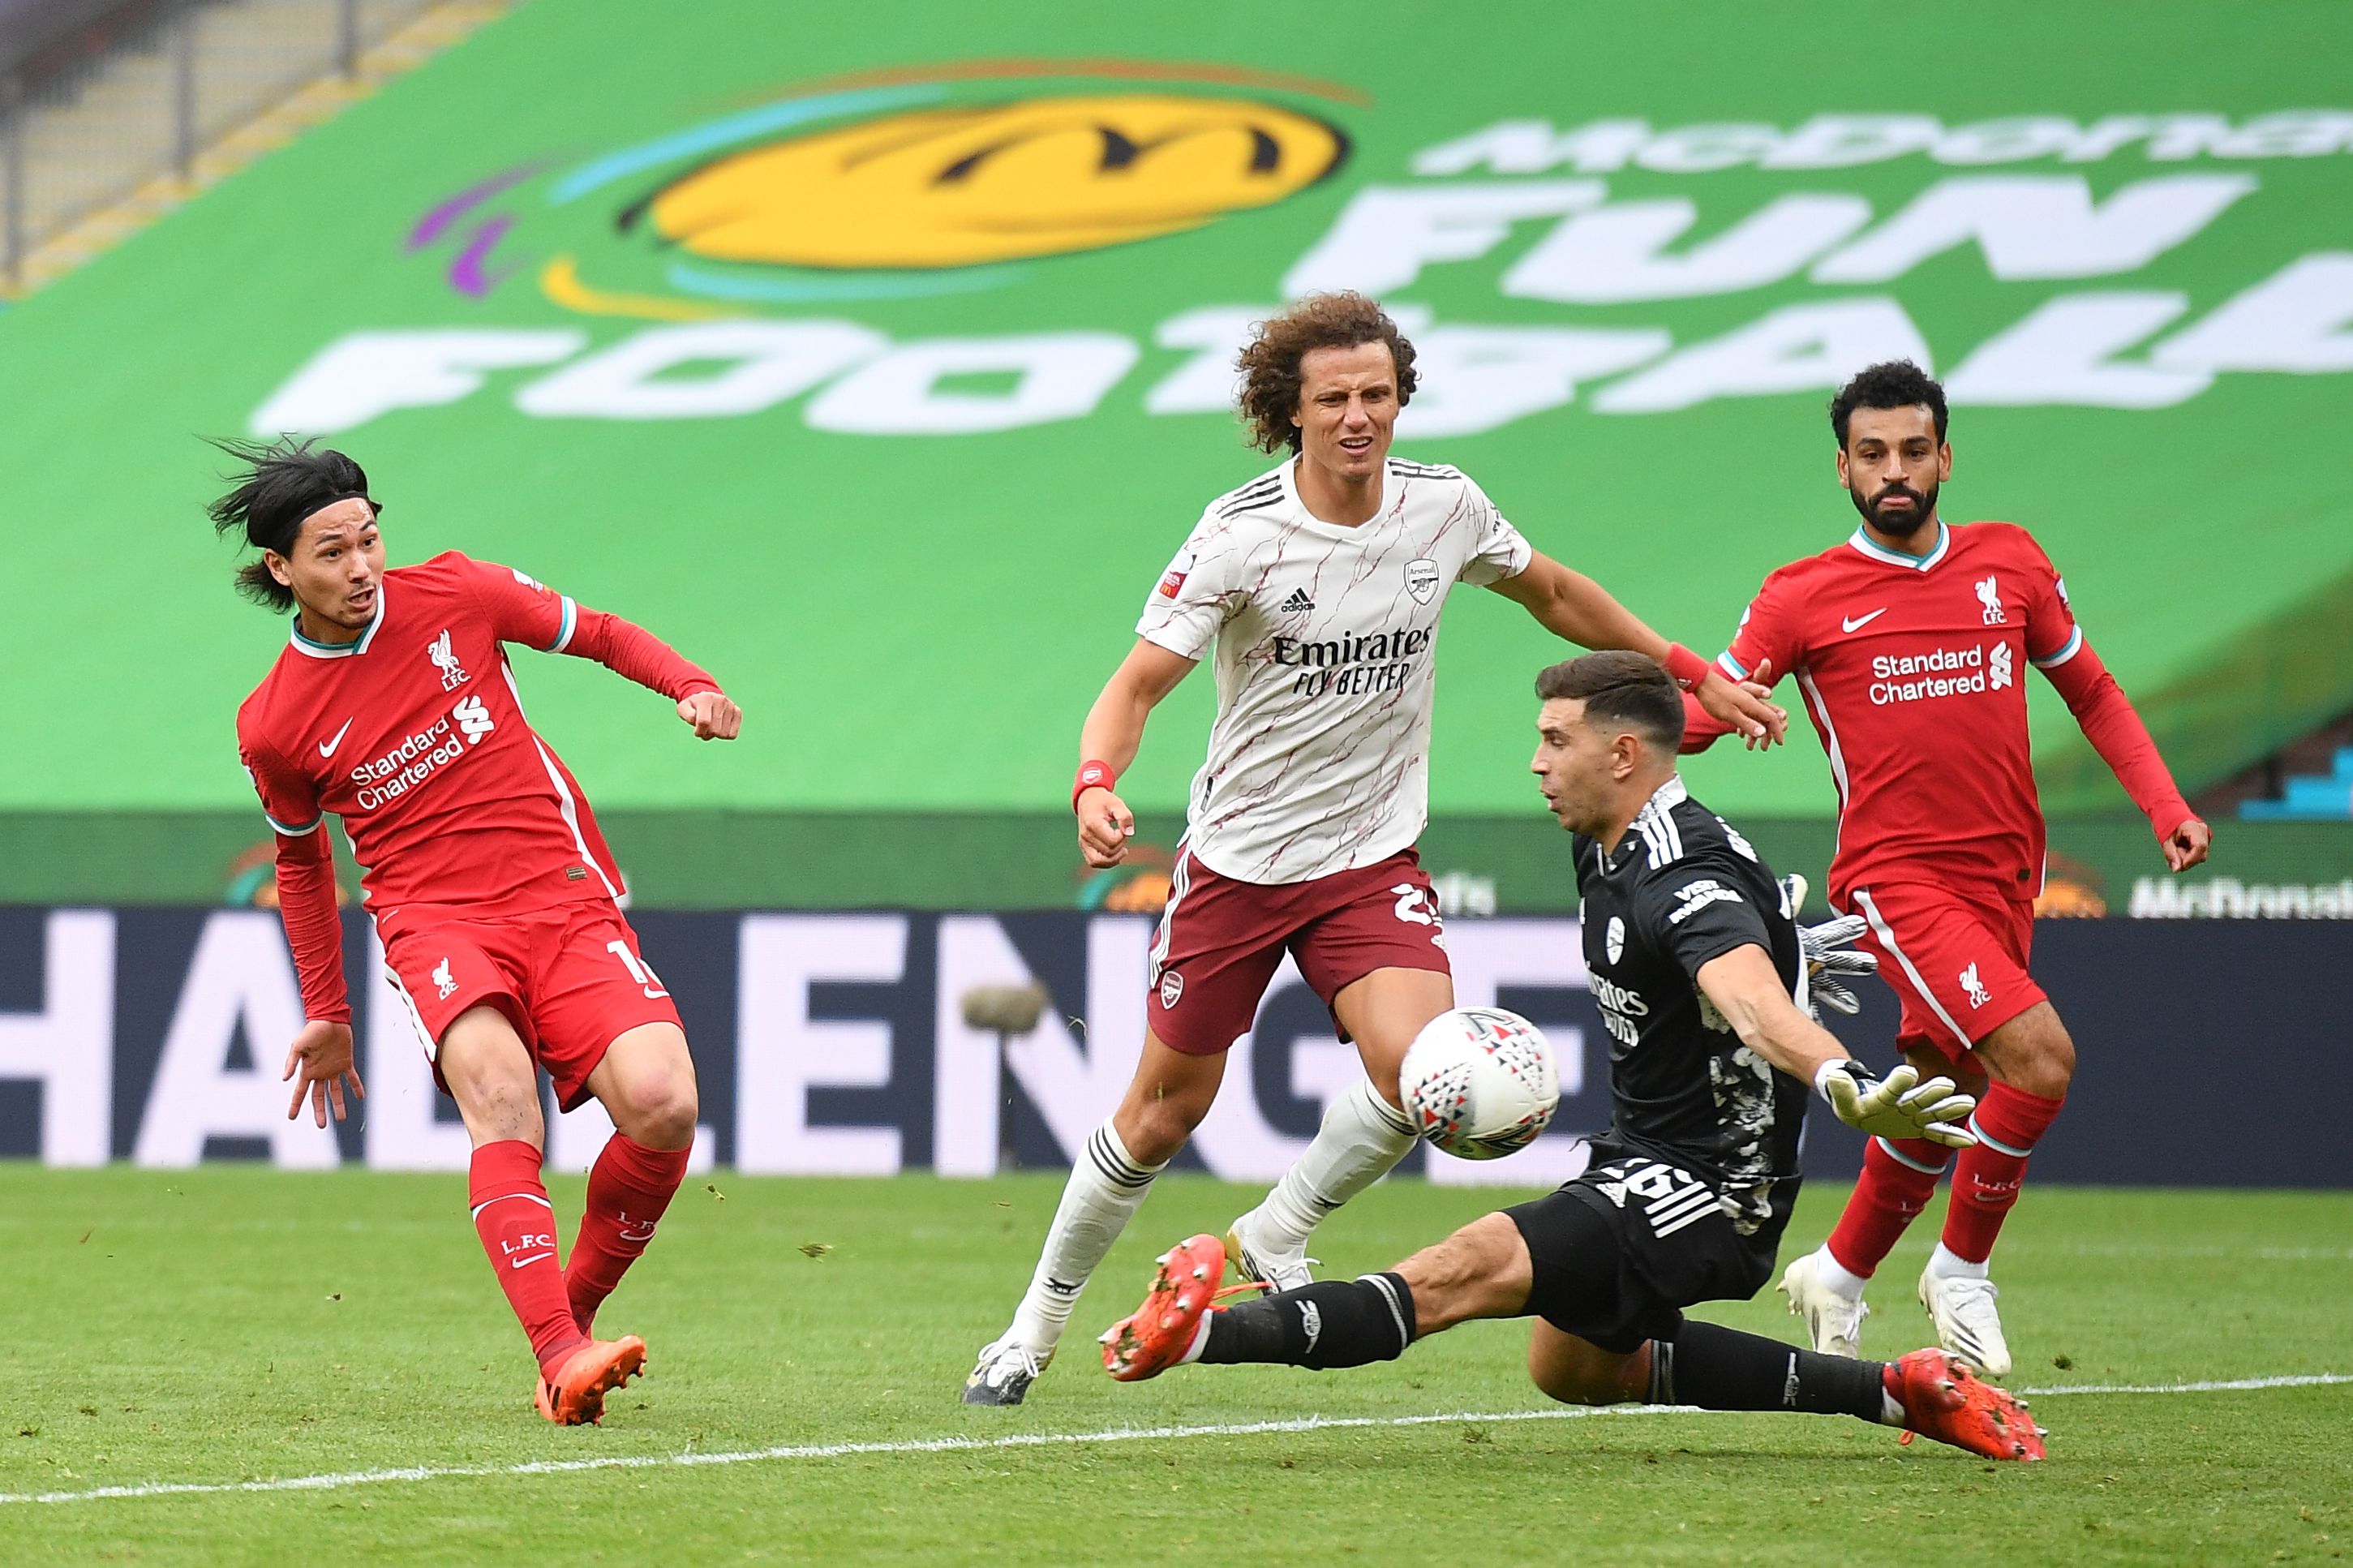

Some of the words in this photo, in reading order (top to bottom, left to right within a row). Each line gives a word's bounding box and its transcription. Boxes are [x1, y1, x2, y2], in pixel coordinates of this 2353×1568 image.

[1278, 172, 2261, 304] FUN
[1281, 603, 1316, 613] adidas
[1272, 625, 1432, 668] Emirates
[1872, 643, 1982, 679] Standard
[1293, 671, 1333, 697] FLY
[1335, 663, 1411, 696] BETTER
[1869, 669, 1986, 706] Chartered
[350, 715, 450, 786] Standard
[357, 732, 464, 810] Chartered
[606, 939, 672, 999] 1
[500, 1233, 556, 1256] L.F.C.
